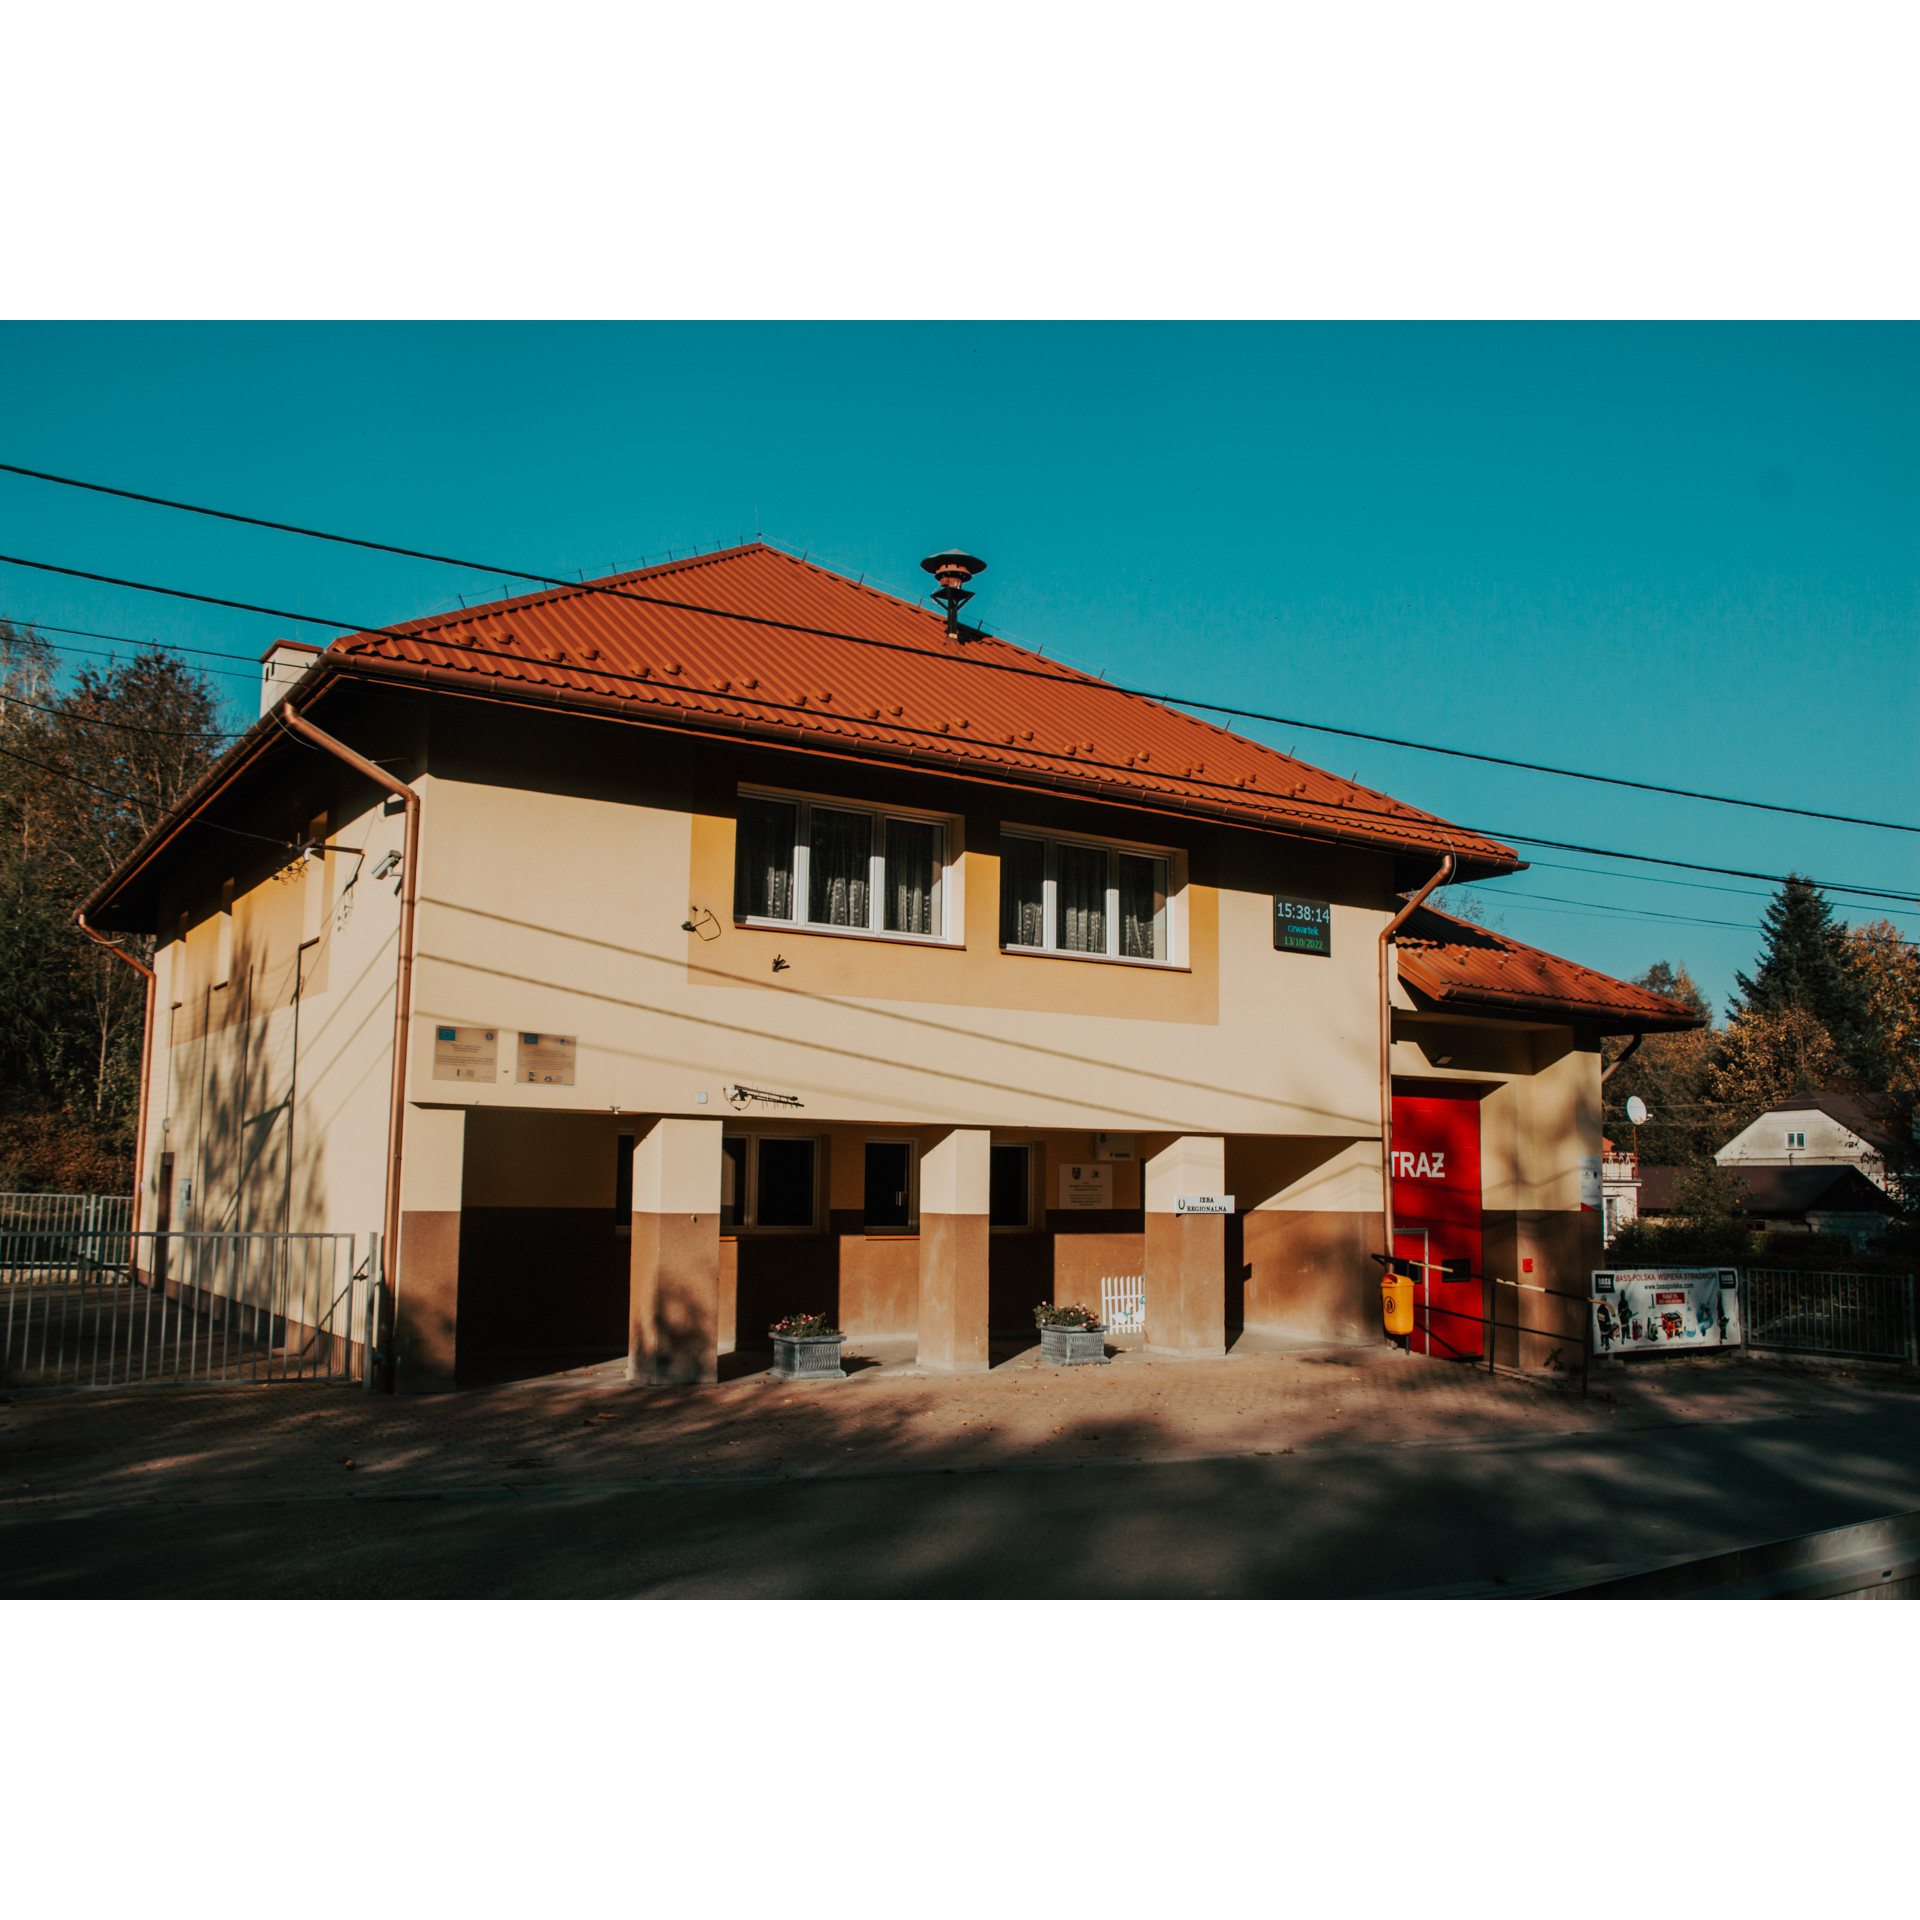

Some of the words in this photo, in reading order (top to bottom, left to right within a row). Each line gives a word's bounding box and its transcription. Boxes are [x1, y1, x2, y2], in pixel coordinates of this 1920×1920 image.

[1277, 902, 1330, 924] 15:38:14
[1287, 924, 1319, 936] czwartek
[1284, 936, 1323, 949] 13/10/2022
[1390, 1151, 1446, 1178] TRAŻ
[1615, 1274, 1632, 1282] BASS
[1632, 1273, 1656, 1282] POLSKA
[1644, 1282, 1694, 1291] www.basspolska.com
